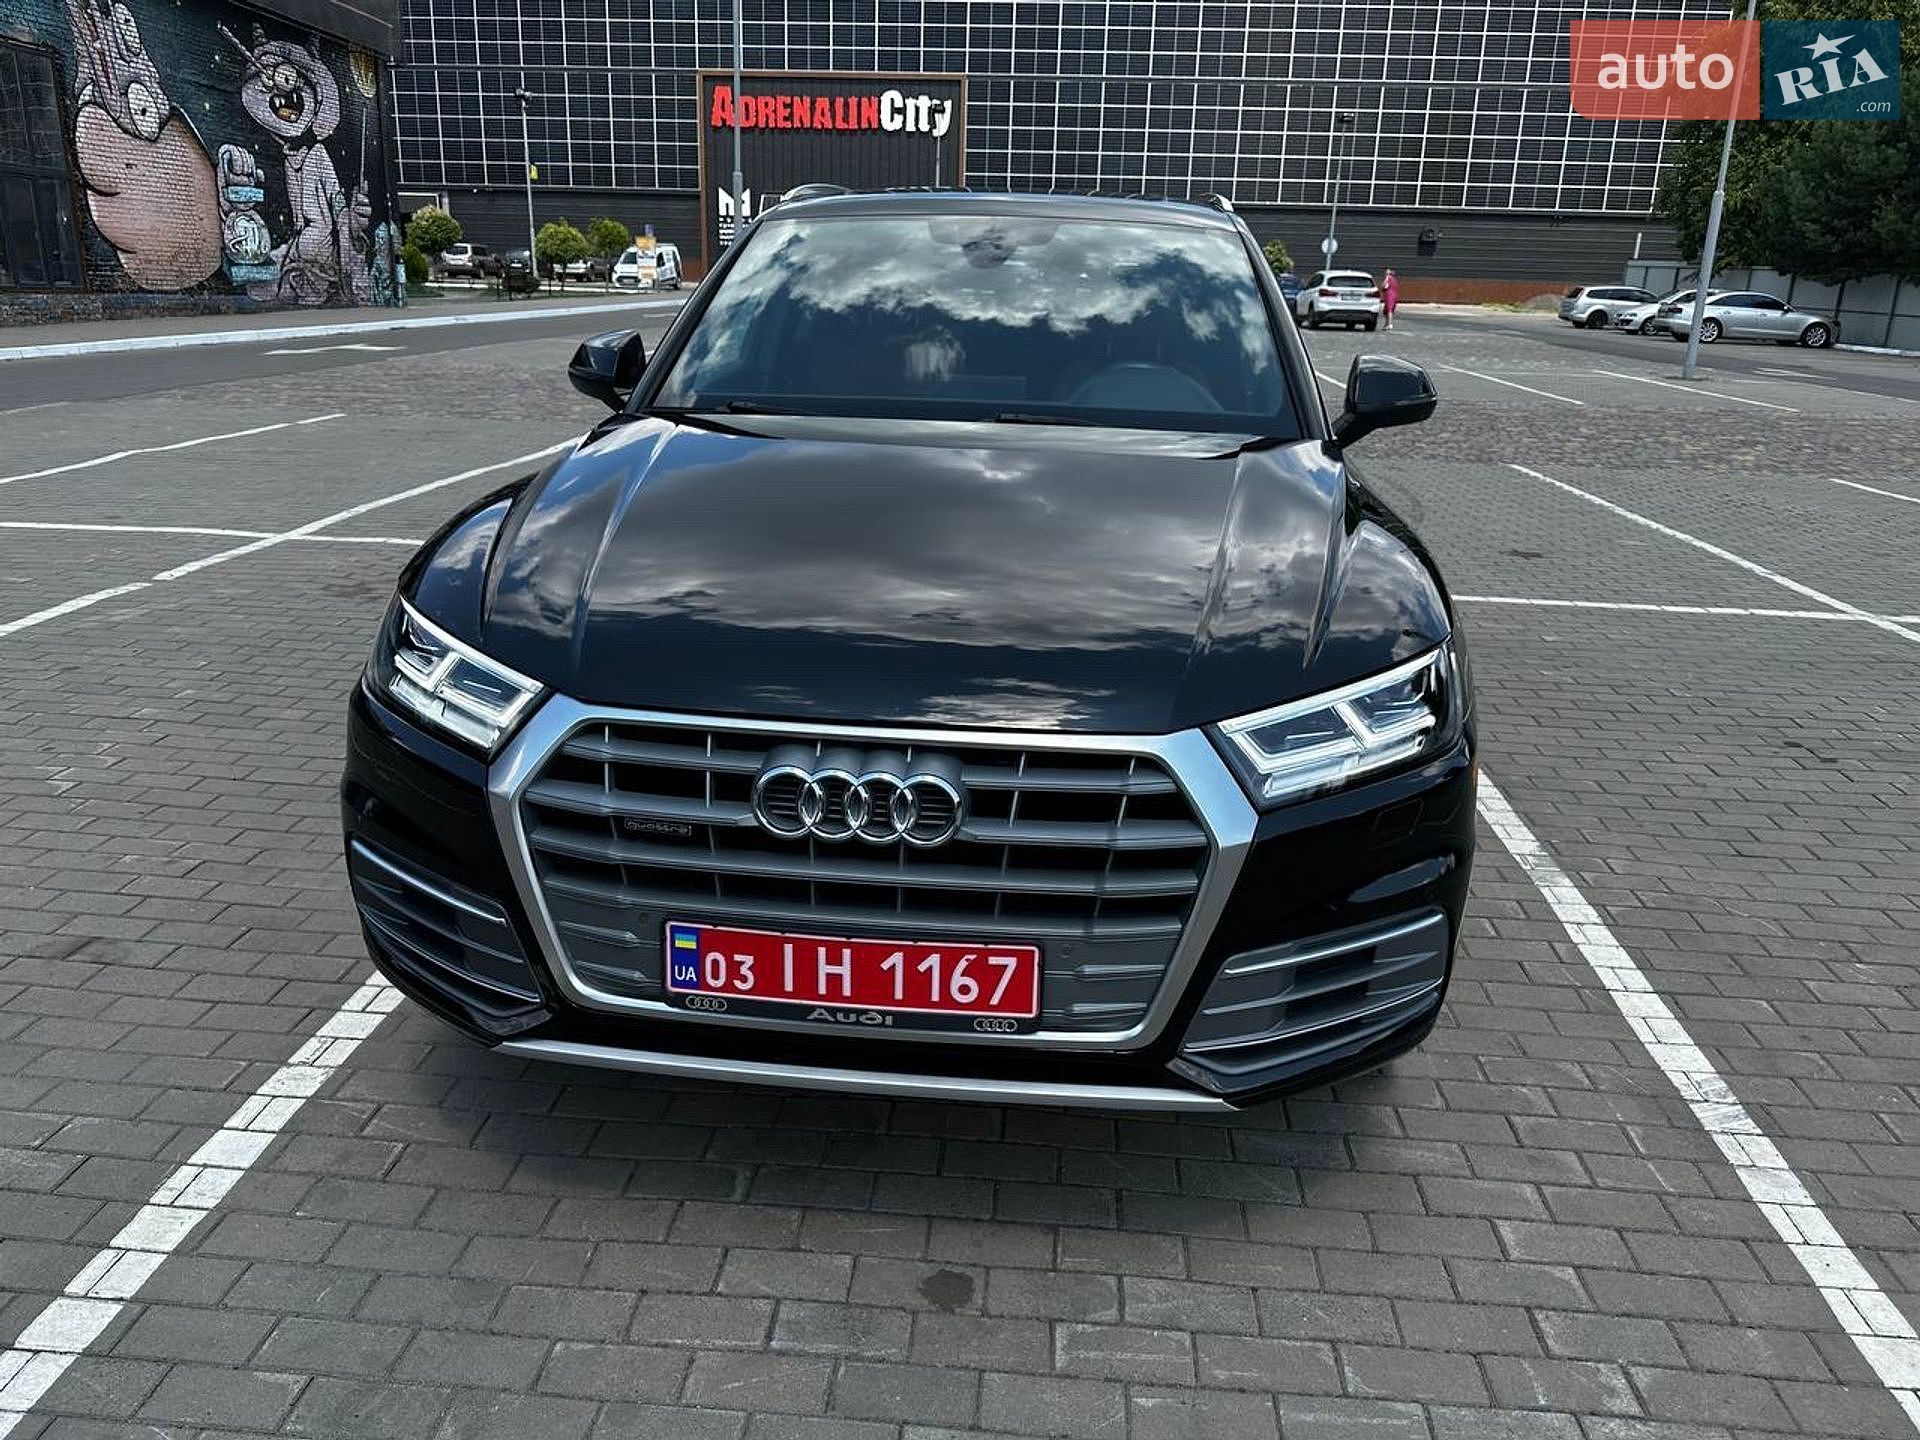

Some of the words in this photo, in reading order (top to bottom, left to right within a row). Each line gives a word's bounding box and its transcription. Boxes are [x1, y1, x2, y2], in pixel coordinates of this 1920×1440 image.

[674, 964, 697, 983] UA
[704, 952, 755, 991] 03
[879, 951, 1018, 1006] 1167
[806, 1008, 894, 1026] Audi
